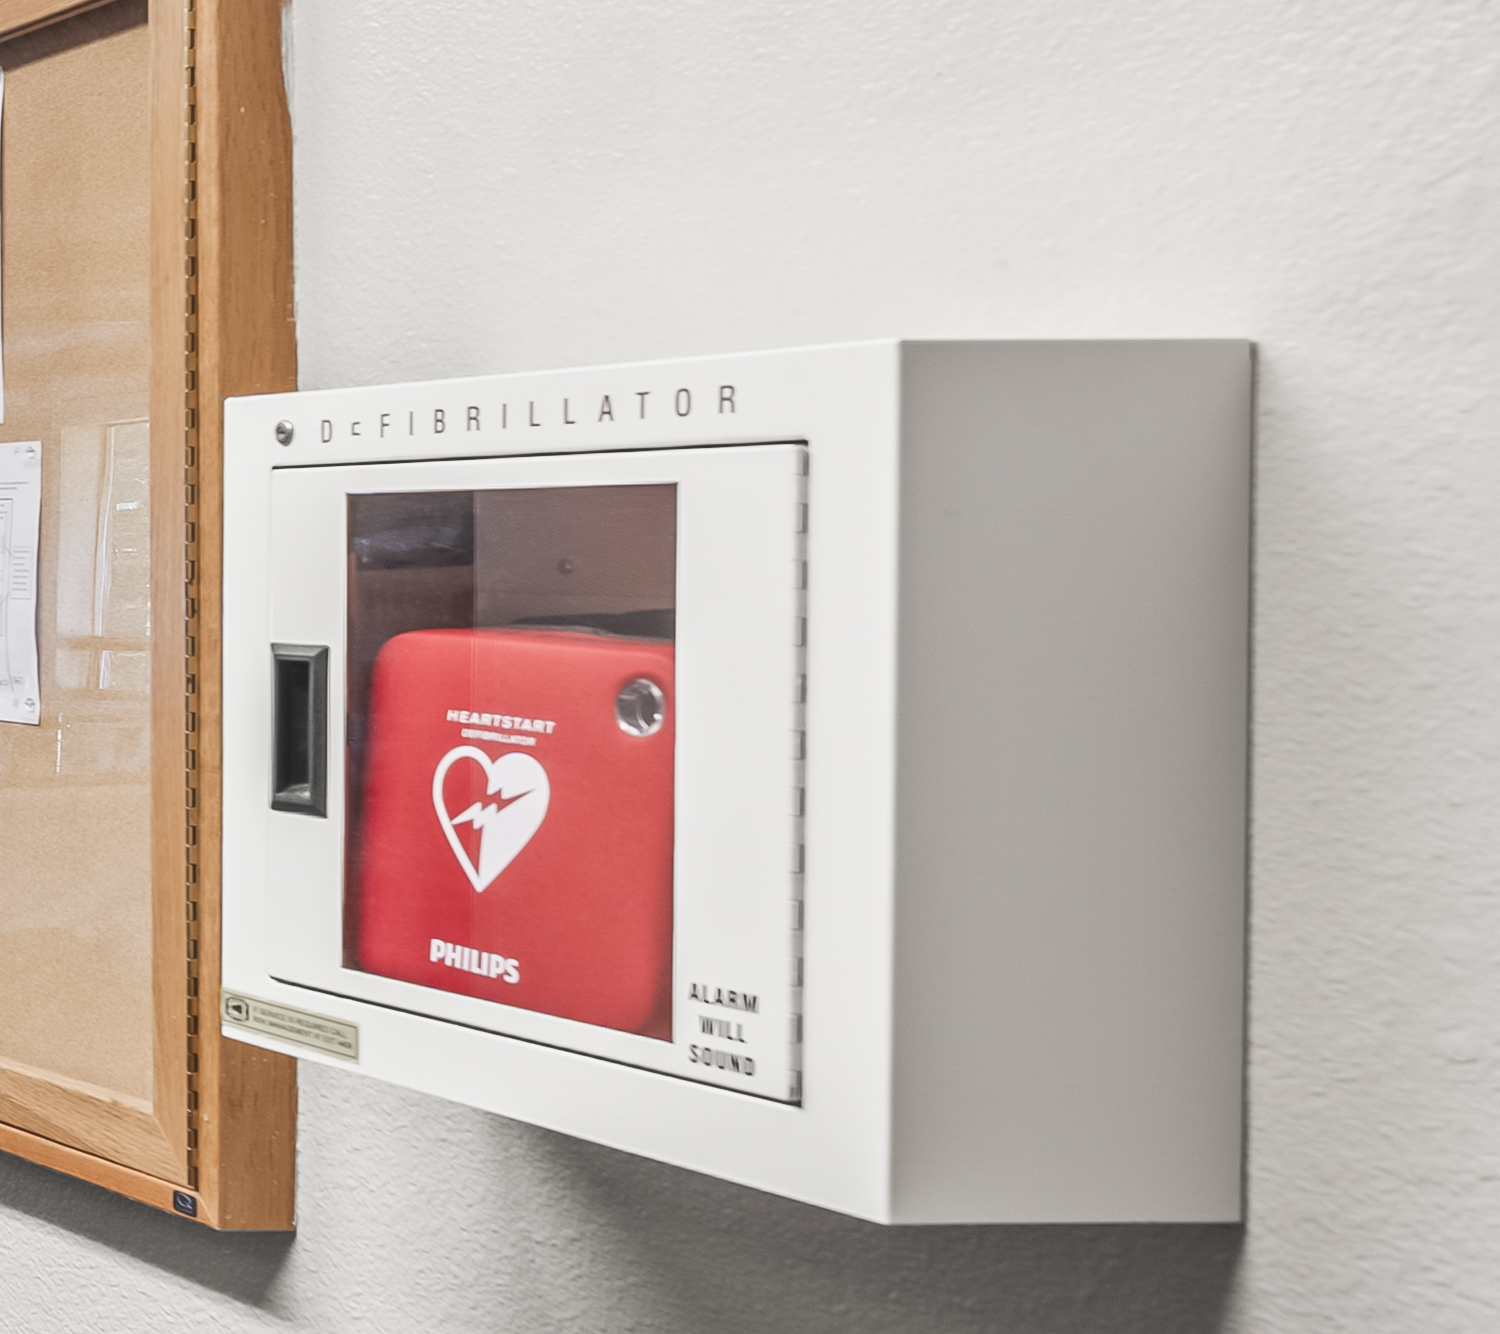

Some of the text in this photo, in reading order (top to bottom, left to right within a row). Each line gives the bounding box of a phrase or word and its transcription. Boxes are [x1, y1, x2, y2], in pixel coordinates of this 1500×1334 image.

[446, 709, 556, 734] HEARTSTART
[429, 938, 520, 984] PHILIPS
[688, 983, 760, 1014] ALARM
[698, 1015, 748, 1044] WILL
[688, 1044, 756, 1076] SOUND
